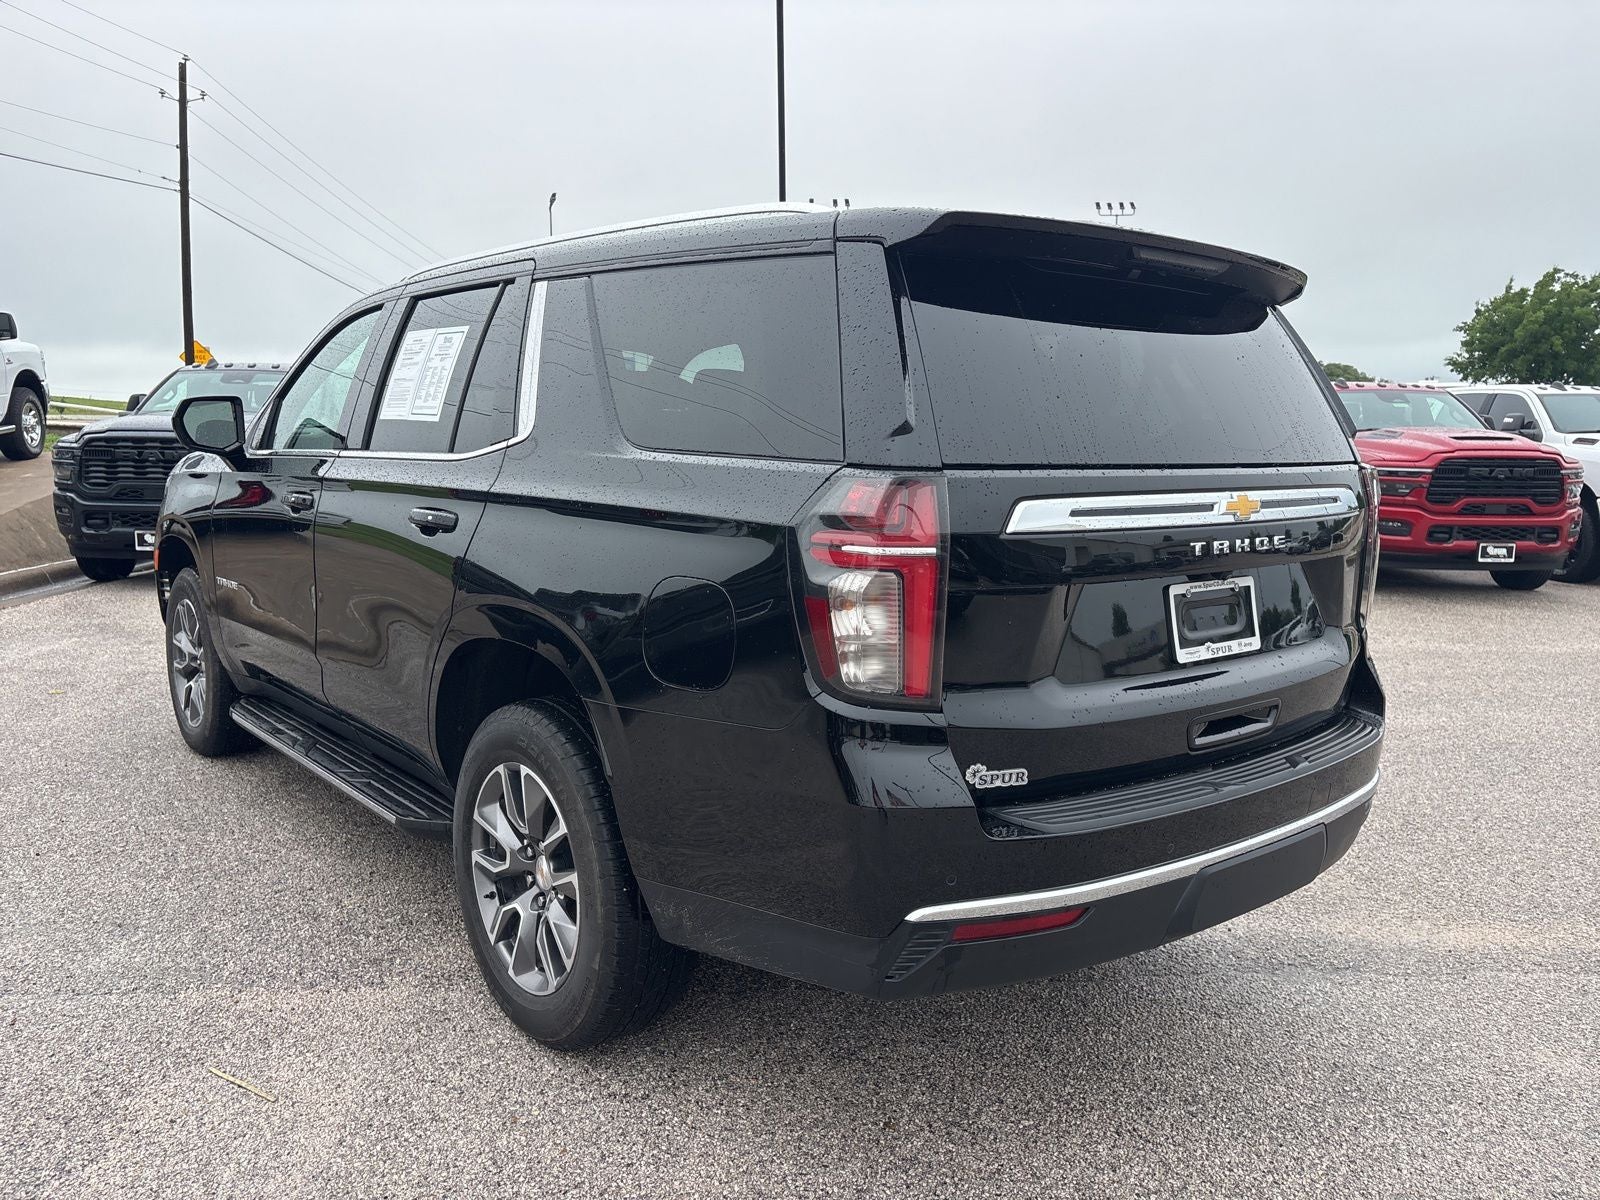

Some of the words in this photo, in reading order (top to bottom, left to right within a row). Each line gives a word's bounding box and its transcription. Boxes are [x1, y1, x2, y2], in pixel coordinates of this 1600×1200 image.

[1468, 467, 1535, 478] RAM
[1189, 535, 1286, 557] TAHOE
[1210, 645, 1234, 656] SPUR
[978, 771, 1027, 787] SPUR
